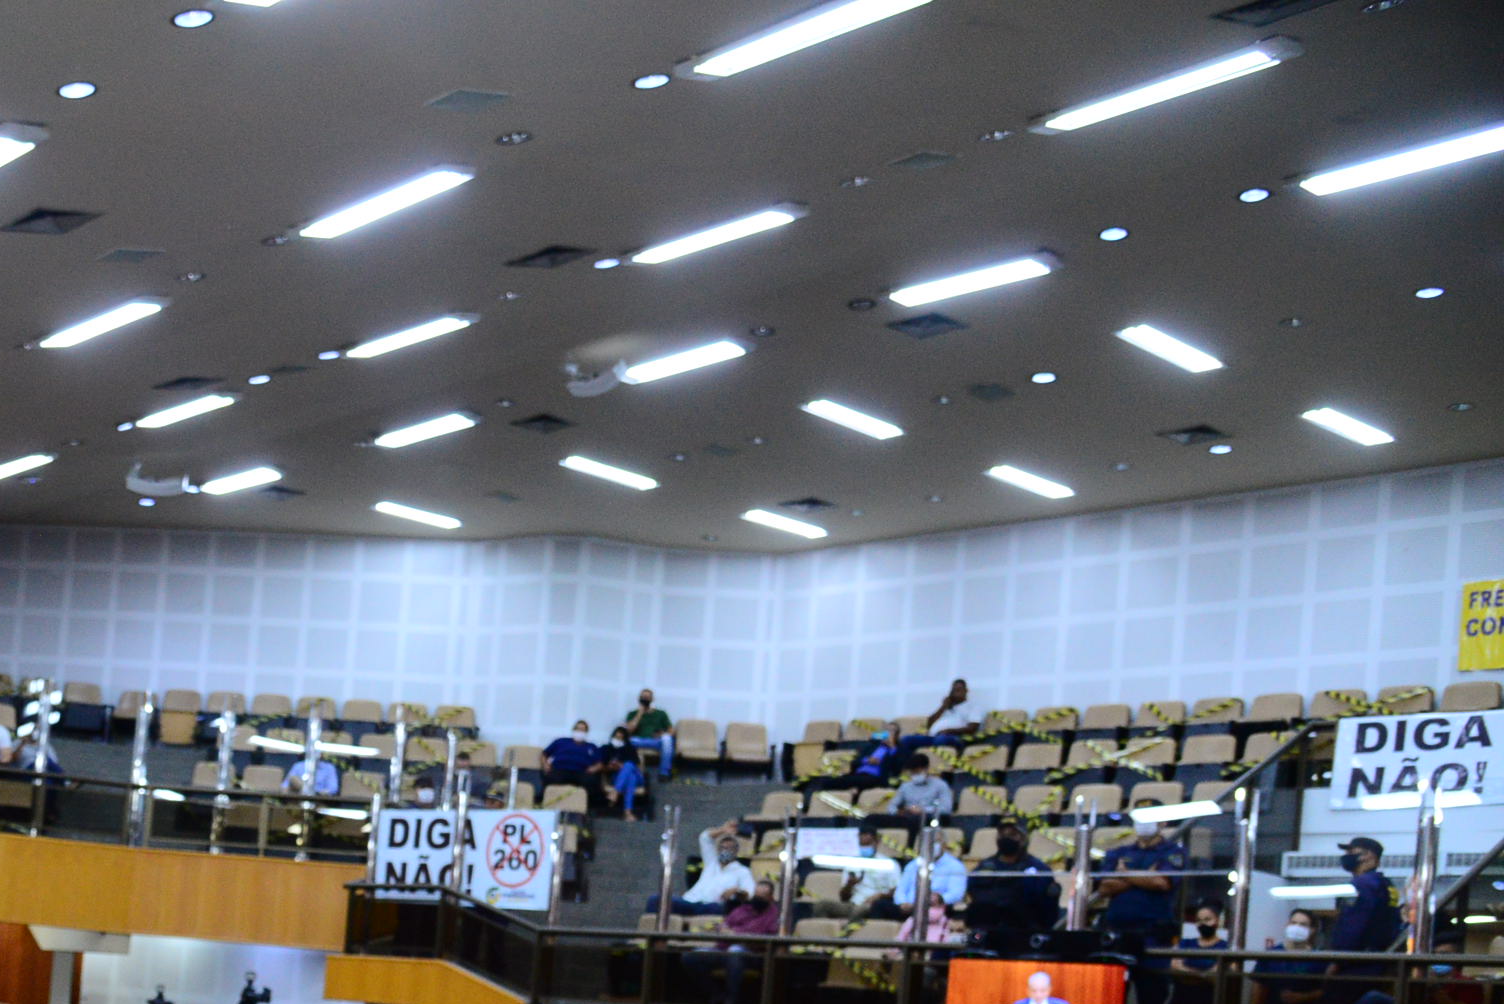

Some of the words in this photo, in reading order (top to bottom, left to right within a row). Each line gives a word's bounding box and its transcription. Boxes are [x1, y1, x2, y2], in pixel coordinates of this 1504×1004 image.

[1354, 715, 1493, 754] DIGA
[1347, 756, 1488, 798] NÃO!
[388, 817, 476, 851] DIGA
[502, 824, 532, 845] PL
[494, 848, 538, 872] 260
